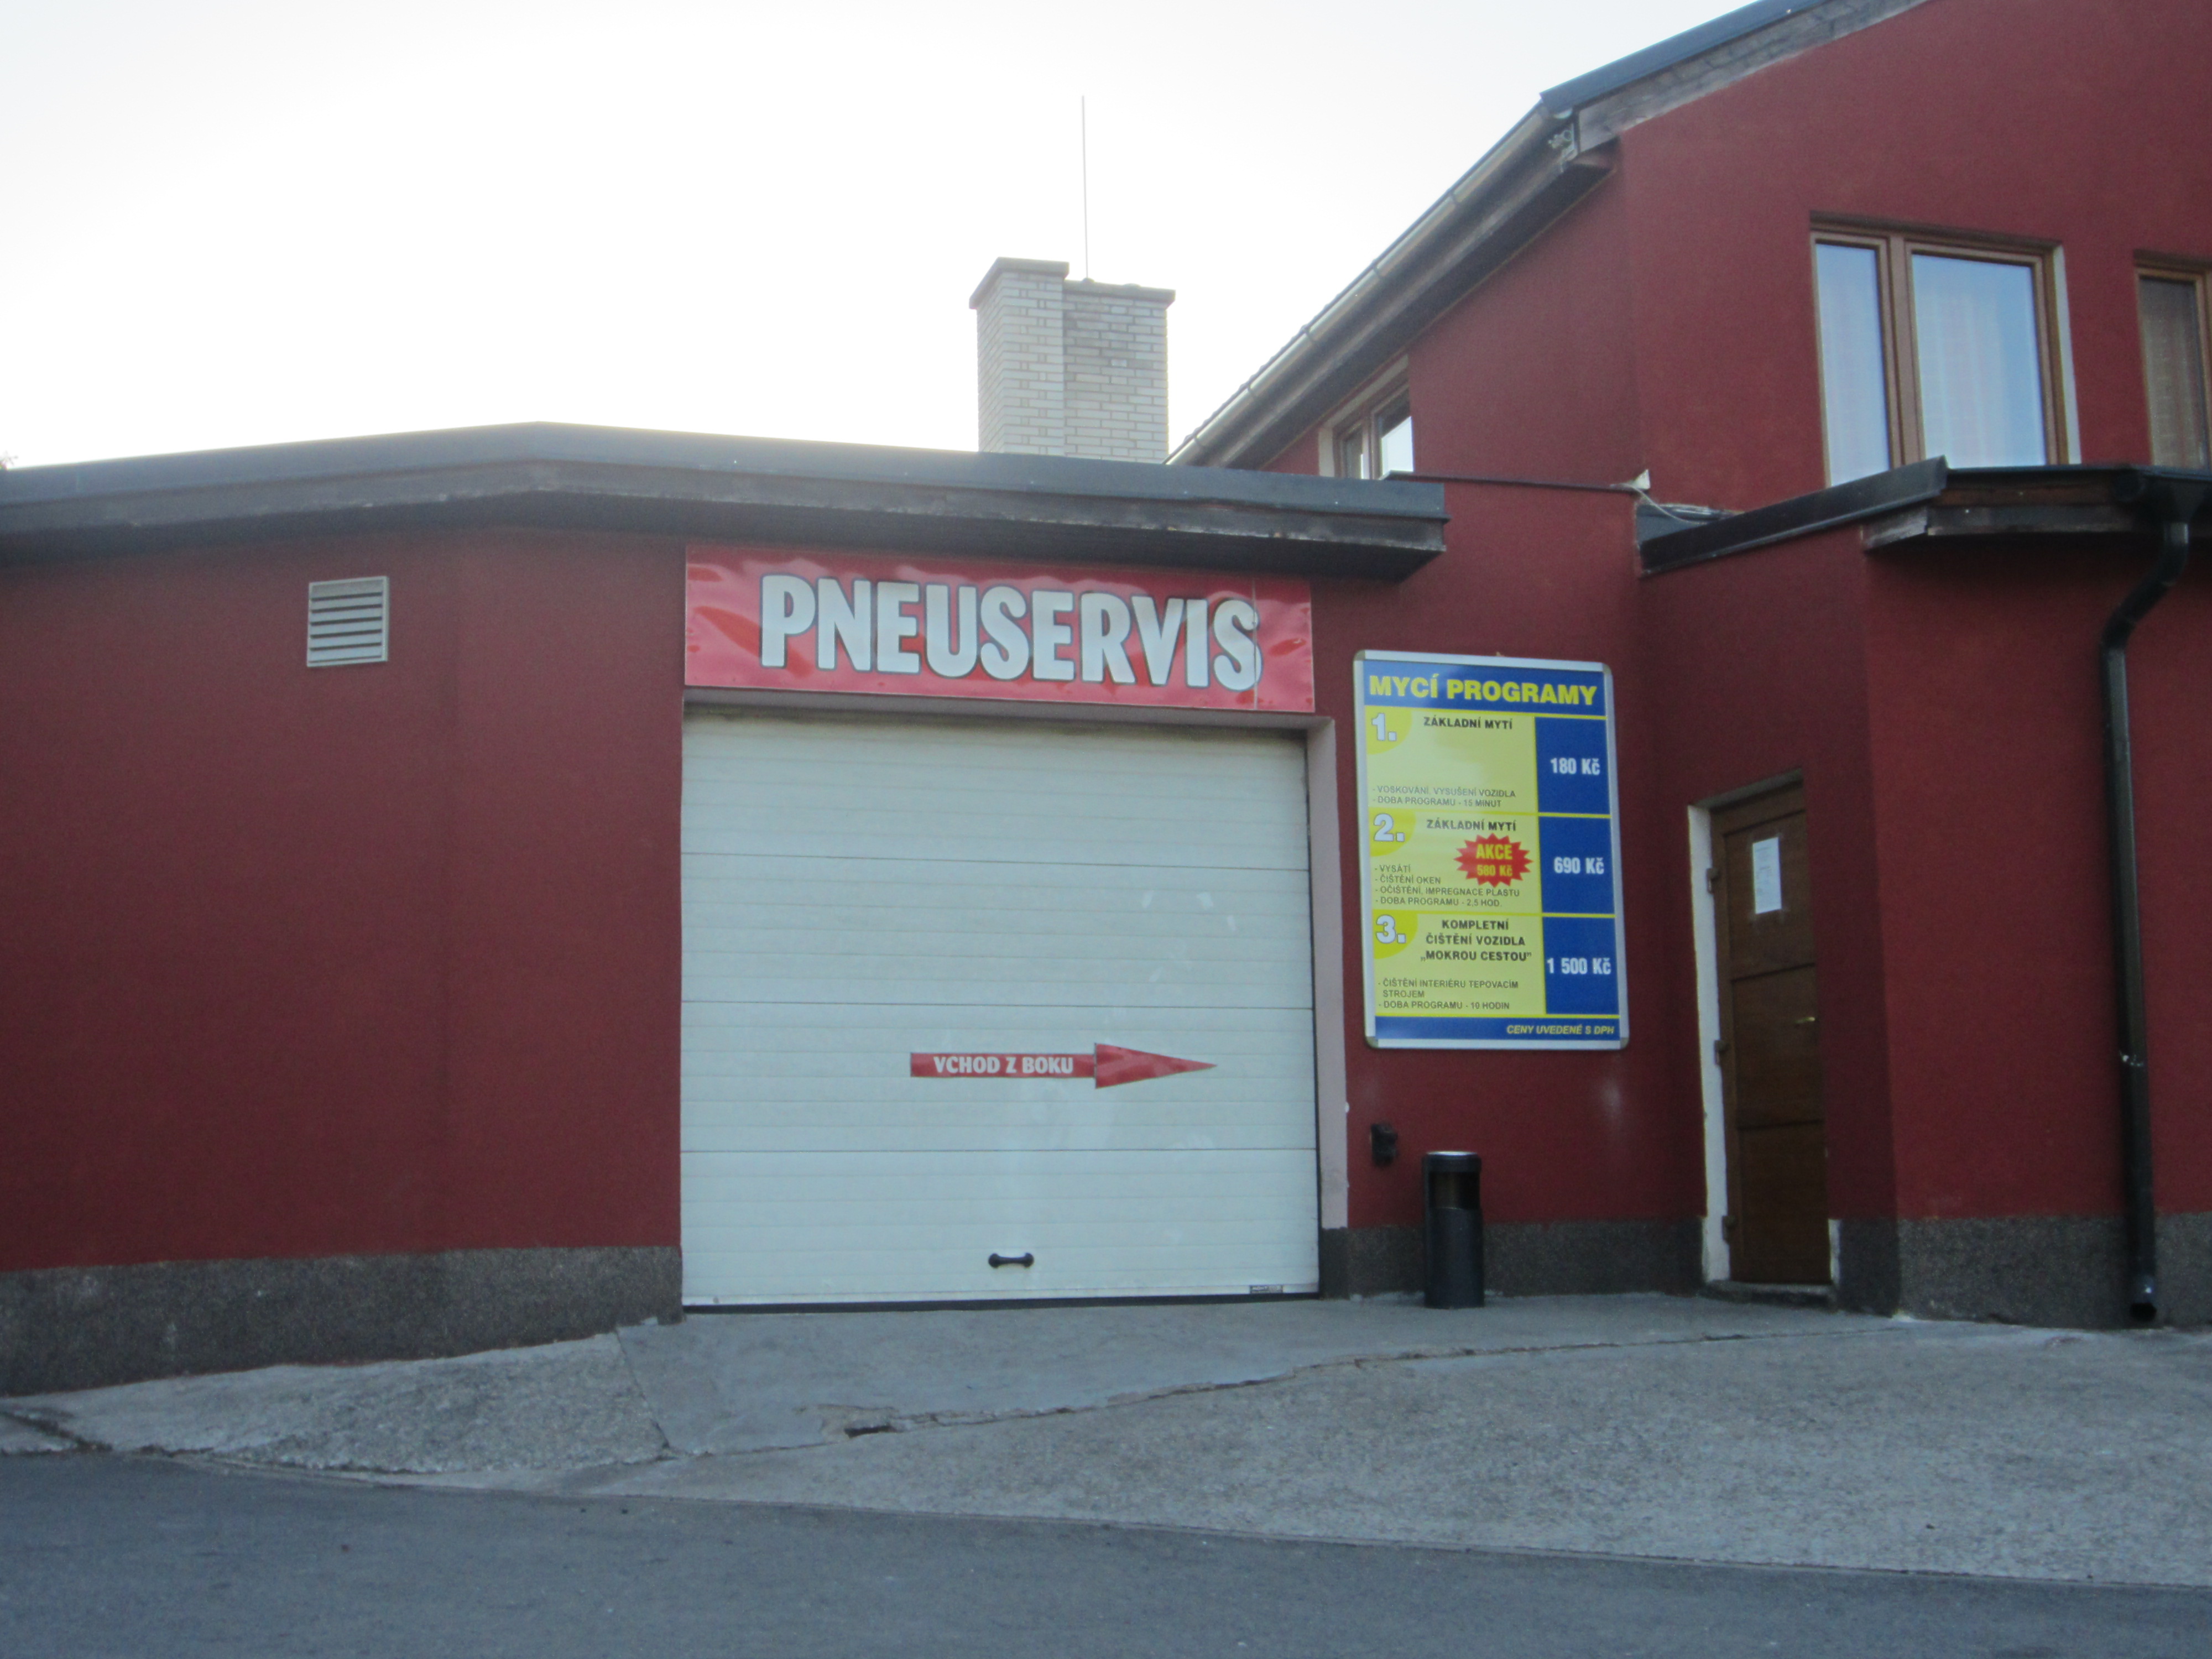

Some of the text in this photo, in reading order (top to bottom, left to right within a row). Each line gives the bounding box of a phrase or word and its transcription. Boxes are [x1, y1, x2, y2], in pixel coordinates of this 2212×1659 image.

[760, 573, 1263, 692] PNEUSERVIS
[1370, 674, 1597, 705] MYCÍ PROGRAMY
[1371, 713, 1397, 741] 1.
[1423, 714, 1513, 729] ZÁKLADNÍ MYTÍ
[1551, 758, 1600, 775] 180 Kč
[1433, 786, 1477, 796] VYSUŠENÍ
[1479, 789, 1516, 797] VOZIDLA
[1378, 796, 1403, 804] DOBA
[1405, 797, 1455, 806] PROGRAMU
[1373, 813, 1405, 842] 2.
[1426, 817, 1516, 831] ZÁKLADNÍ MYTÍ
[1476, 844, 1512, 860] AKCE
[1380, 864, 1411, 873] VYSÁTÍ
[1477, 864, 1512, 877] 580 Kč
[1554, 857, 1604, 874] 690 Kč
[1380, 874, 1413, 884] ČIŠTĚNÍ
[1426, 887, 1483, 896] IMPREGNACE
[1408, 897, 1459, 905] PROGRAMU
[1467, 899, 1478, 907] 2,5
[1375, 915, 1406, 944] 3.
[1442, 919, 1509, 930] KOMPLETNÍ
[1426, 932, 1525, 946] ČIŠTĚNÍ VOZIDLA
[1547, 957, 1611, 975] 1 500 Kč
[1383, 978, 1417, 987] ČIŠTĚNÍ
[1420, 979, 1465, 988] INTERIÉRU
[1469, 979, 1519, 988] TEPOVACÍM
[1411, 1001, 1463, 1009] PROGRAMU
[1506, 1024, 1614, 1035] CENY UVEDENÉ S DPH
[933, 1057, 1073, 1073] VCHOD Z BOKU
